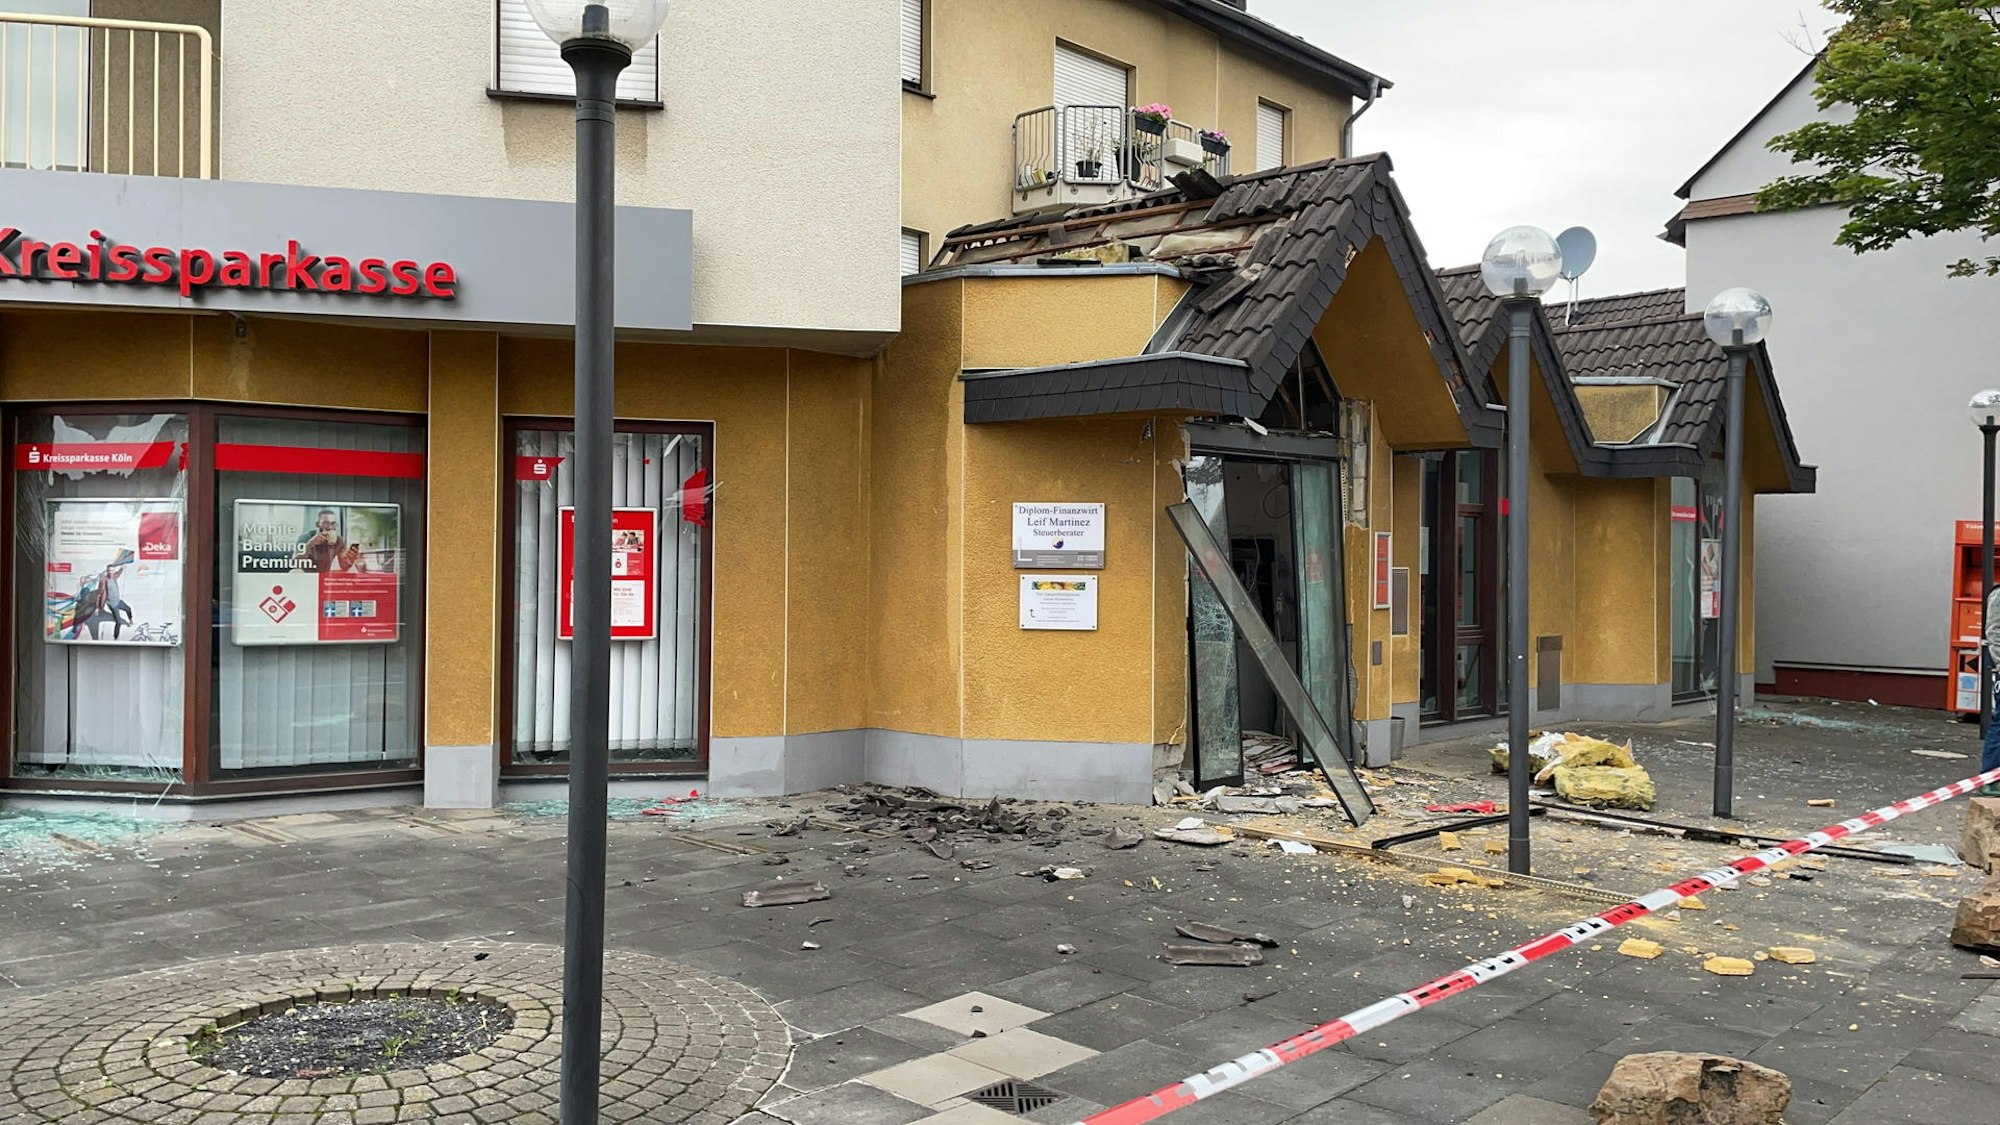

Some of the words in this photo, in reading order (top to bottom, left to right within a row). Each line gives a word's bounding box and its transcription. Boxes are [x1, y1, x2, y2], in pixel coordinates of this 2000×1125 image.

[43, 453, 109, 464] Kreissparkasse
[112, 452, 133, 463] Köln
[1019, 506, 1098, 516] Diplom-Finanzwirt
[1027, 517, 1048, 526] Leif
[1049, 517, 1091, 526] Martinez
[242, 521, 296, 535] Mobile
[1033, 528, 1084, 537] Steuerberater
[144, 542, 171, 551] Deka
[241, 538, 307, 555] Banking
[241, 555, 317, 569] Premium.
